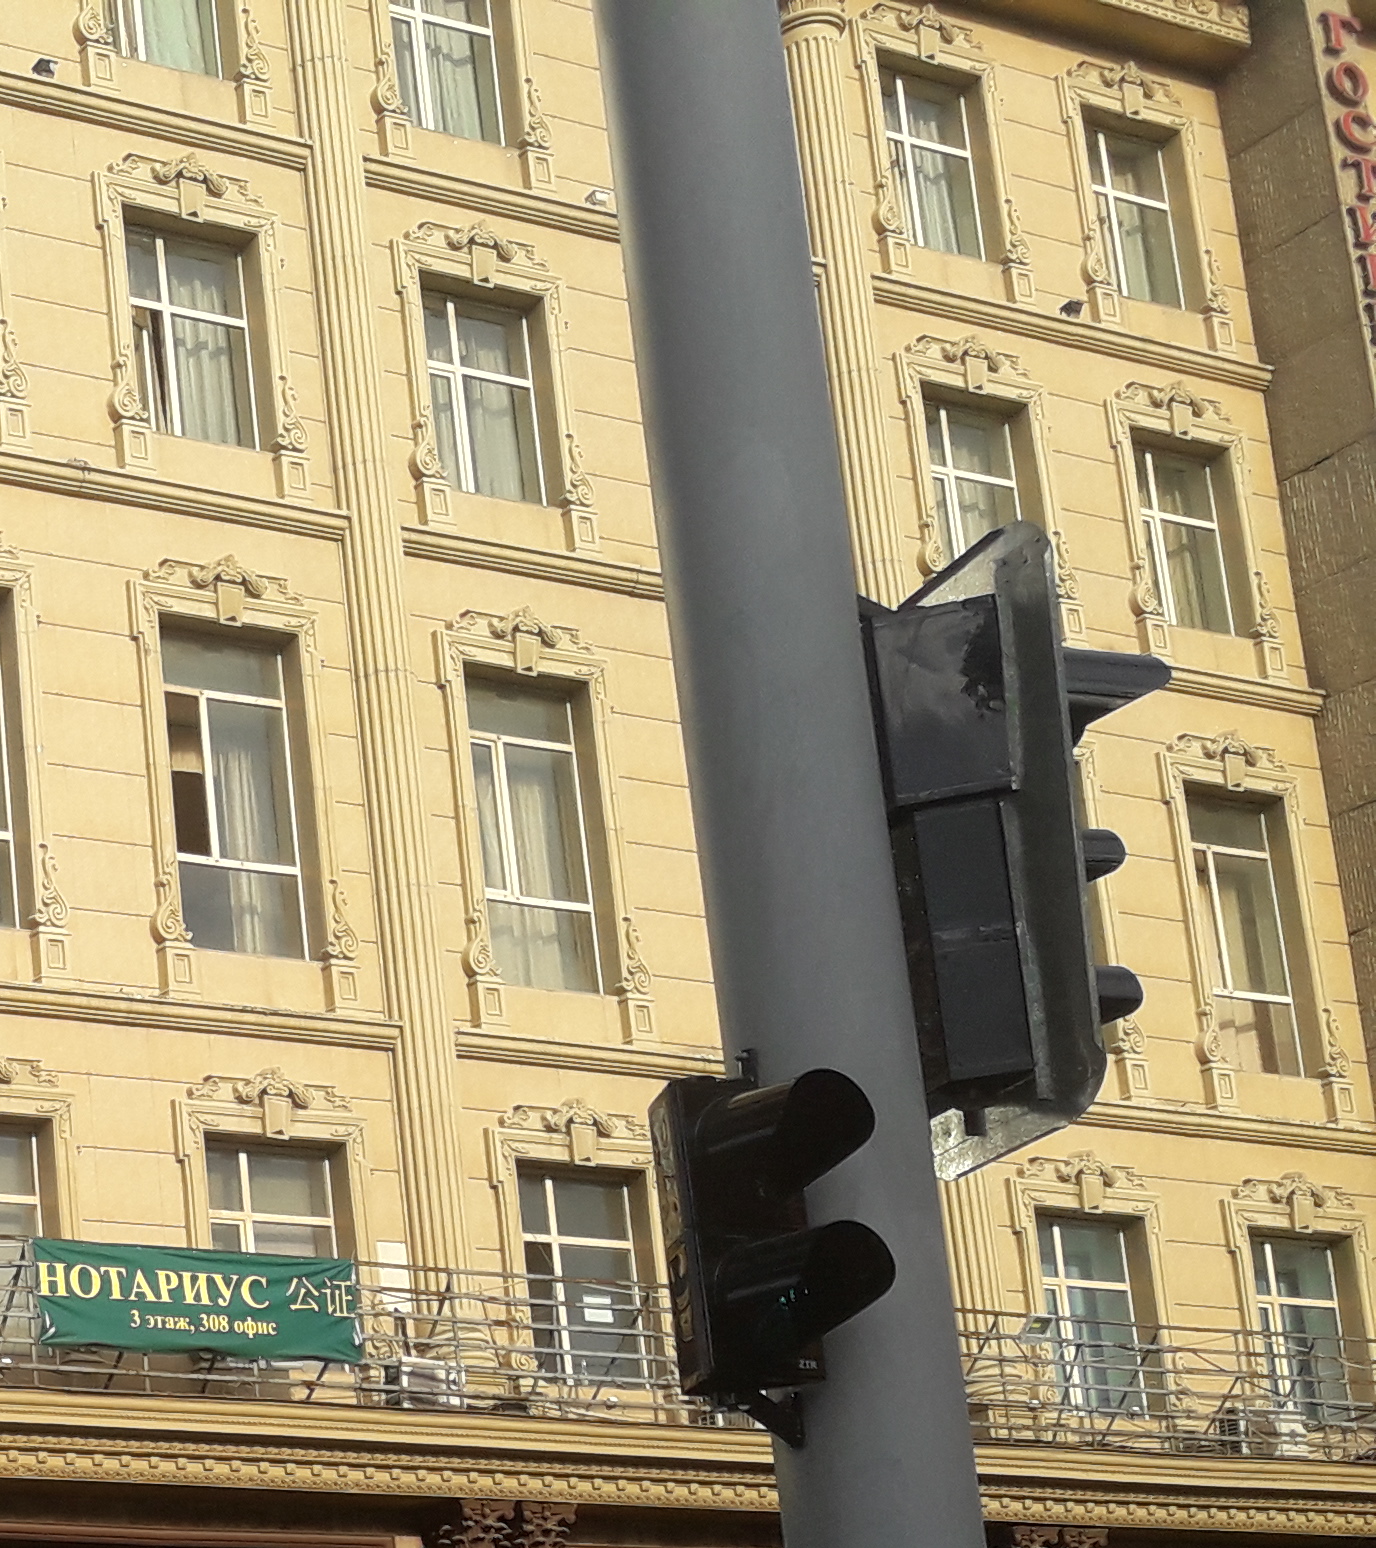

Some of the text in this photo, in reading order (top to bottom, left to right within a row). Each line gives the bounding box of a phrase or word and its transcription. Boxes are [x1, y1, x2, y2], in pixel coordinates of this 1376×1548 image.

[36, 1261, 270, 1309] НОТАРИУС
[130, 1310, 277, 1338] 3 этаж, 308 офис
